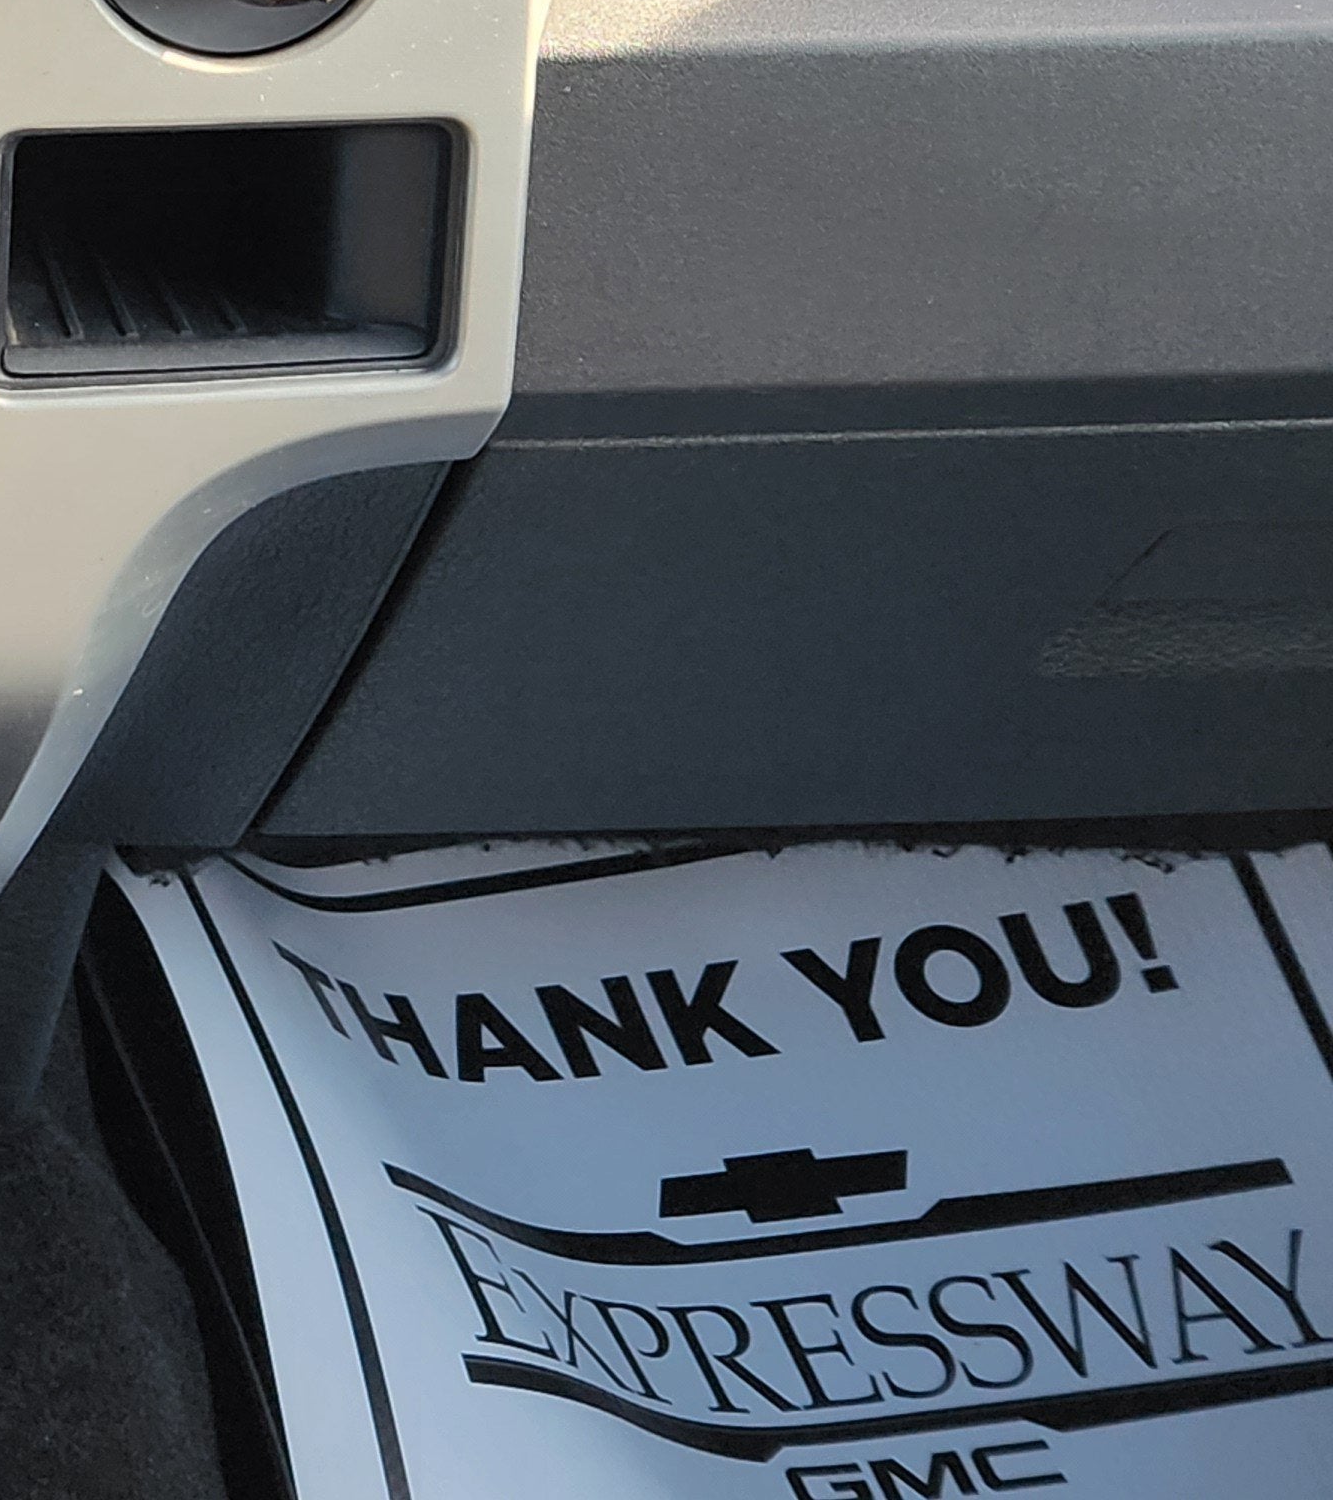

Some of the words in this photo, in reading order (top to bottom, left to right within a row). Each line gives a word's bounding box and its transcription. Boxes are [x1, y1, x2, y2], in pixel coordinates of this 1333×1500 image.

[272, 940, 780, 1084] THANK
[780, 893, 1181, 1042] YOU!
[416, 1205, 1333, 1414] EXPRESSWAY
